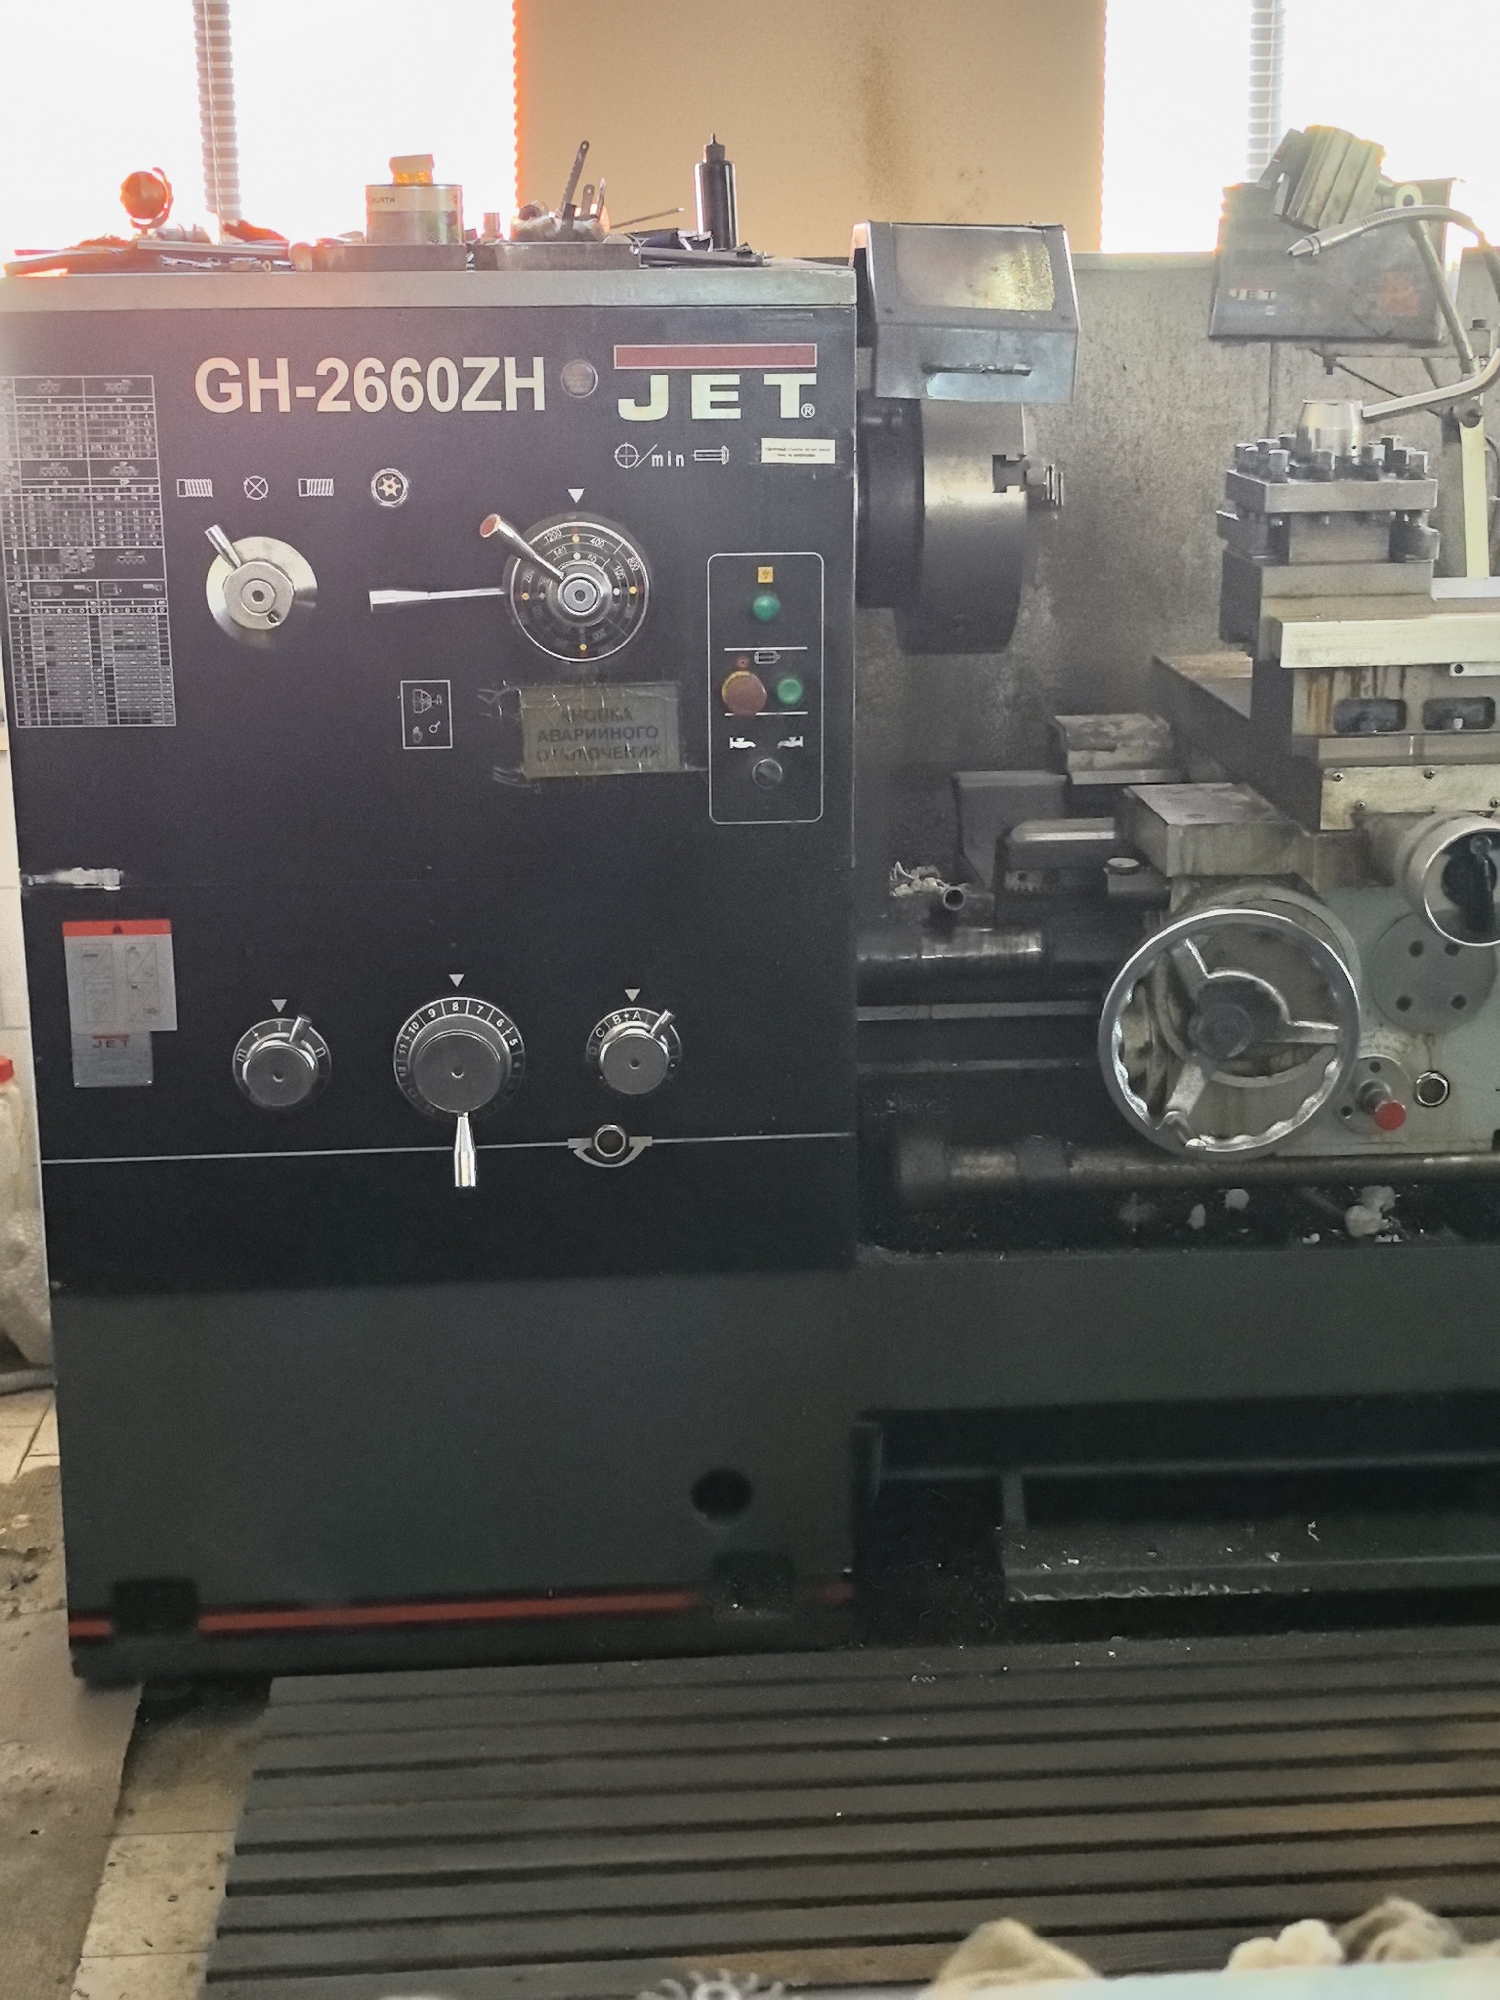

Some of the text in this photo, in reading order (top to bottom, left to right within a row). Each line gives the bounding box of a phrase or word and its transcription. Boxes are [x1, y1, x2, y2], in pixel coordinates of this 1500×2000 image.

[195, 356, 546, 413] GH-2660ZH
[408, 1021, 419, 1034] 10
[428, 1008, 436, 1018] 9
[452, 1001, 460, 1012] 8
[476, 1004, 485, 1015] 7
[496, 1018, 504, 1027] 6
[595, 1027, 605, 1038] C
[612, 1014, 622, 1025] B
[632, 1010, 642, 1021] A
[93, 1039, 128, 1048] JET
